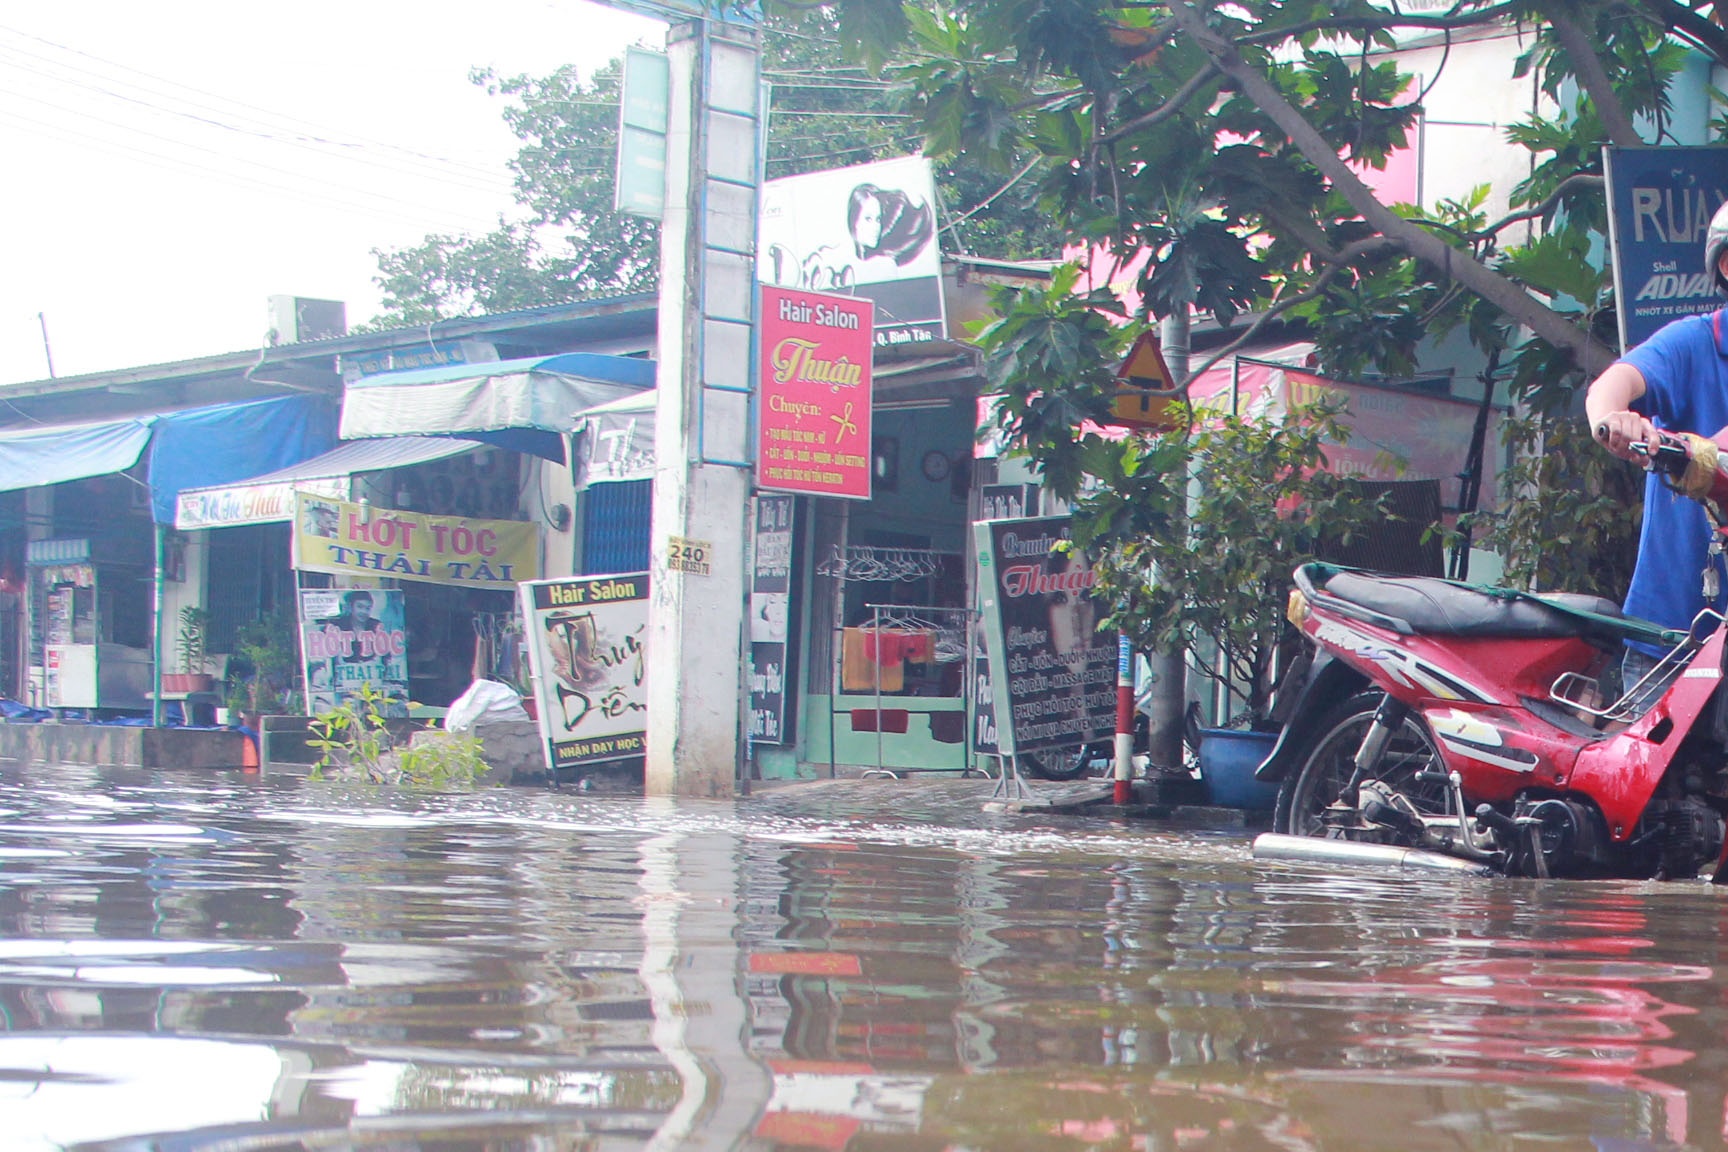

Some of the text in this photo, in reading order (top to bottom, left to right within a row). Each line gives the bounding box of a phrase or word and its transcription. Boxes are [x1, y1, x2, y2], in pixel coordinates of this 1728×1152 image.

[779, 299, 859, 330] Hair Salon
[770, 337, 863, 393] Thuận
[430, 520, 497, 557] TÓC
[670, 544, 704, 562] 240
[447, 559, 514, 582] TÀI
[551, 579, 636, 605] Hair Salon
